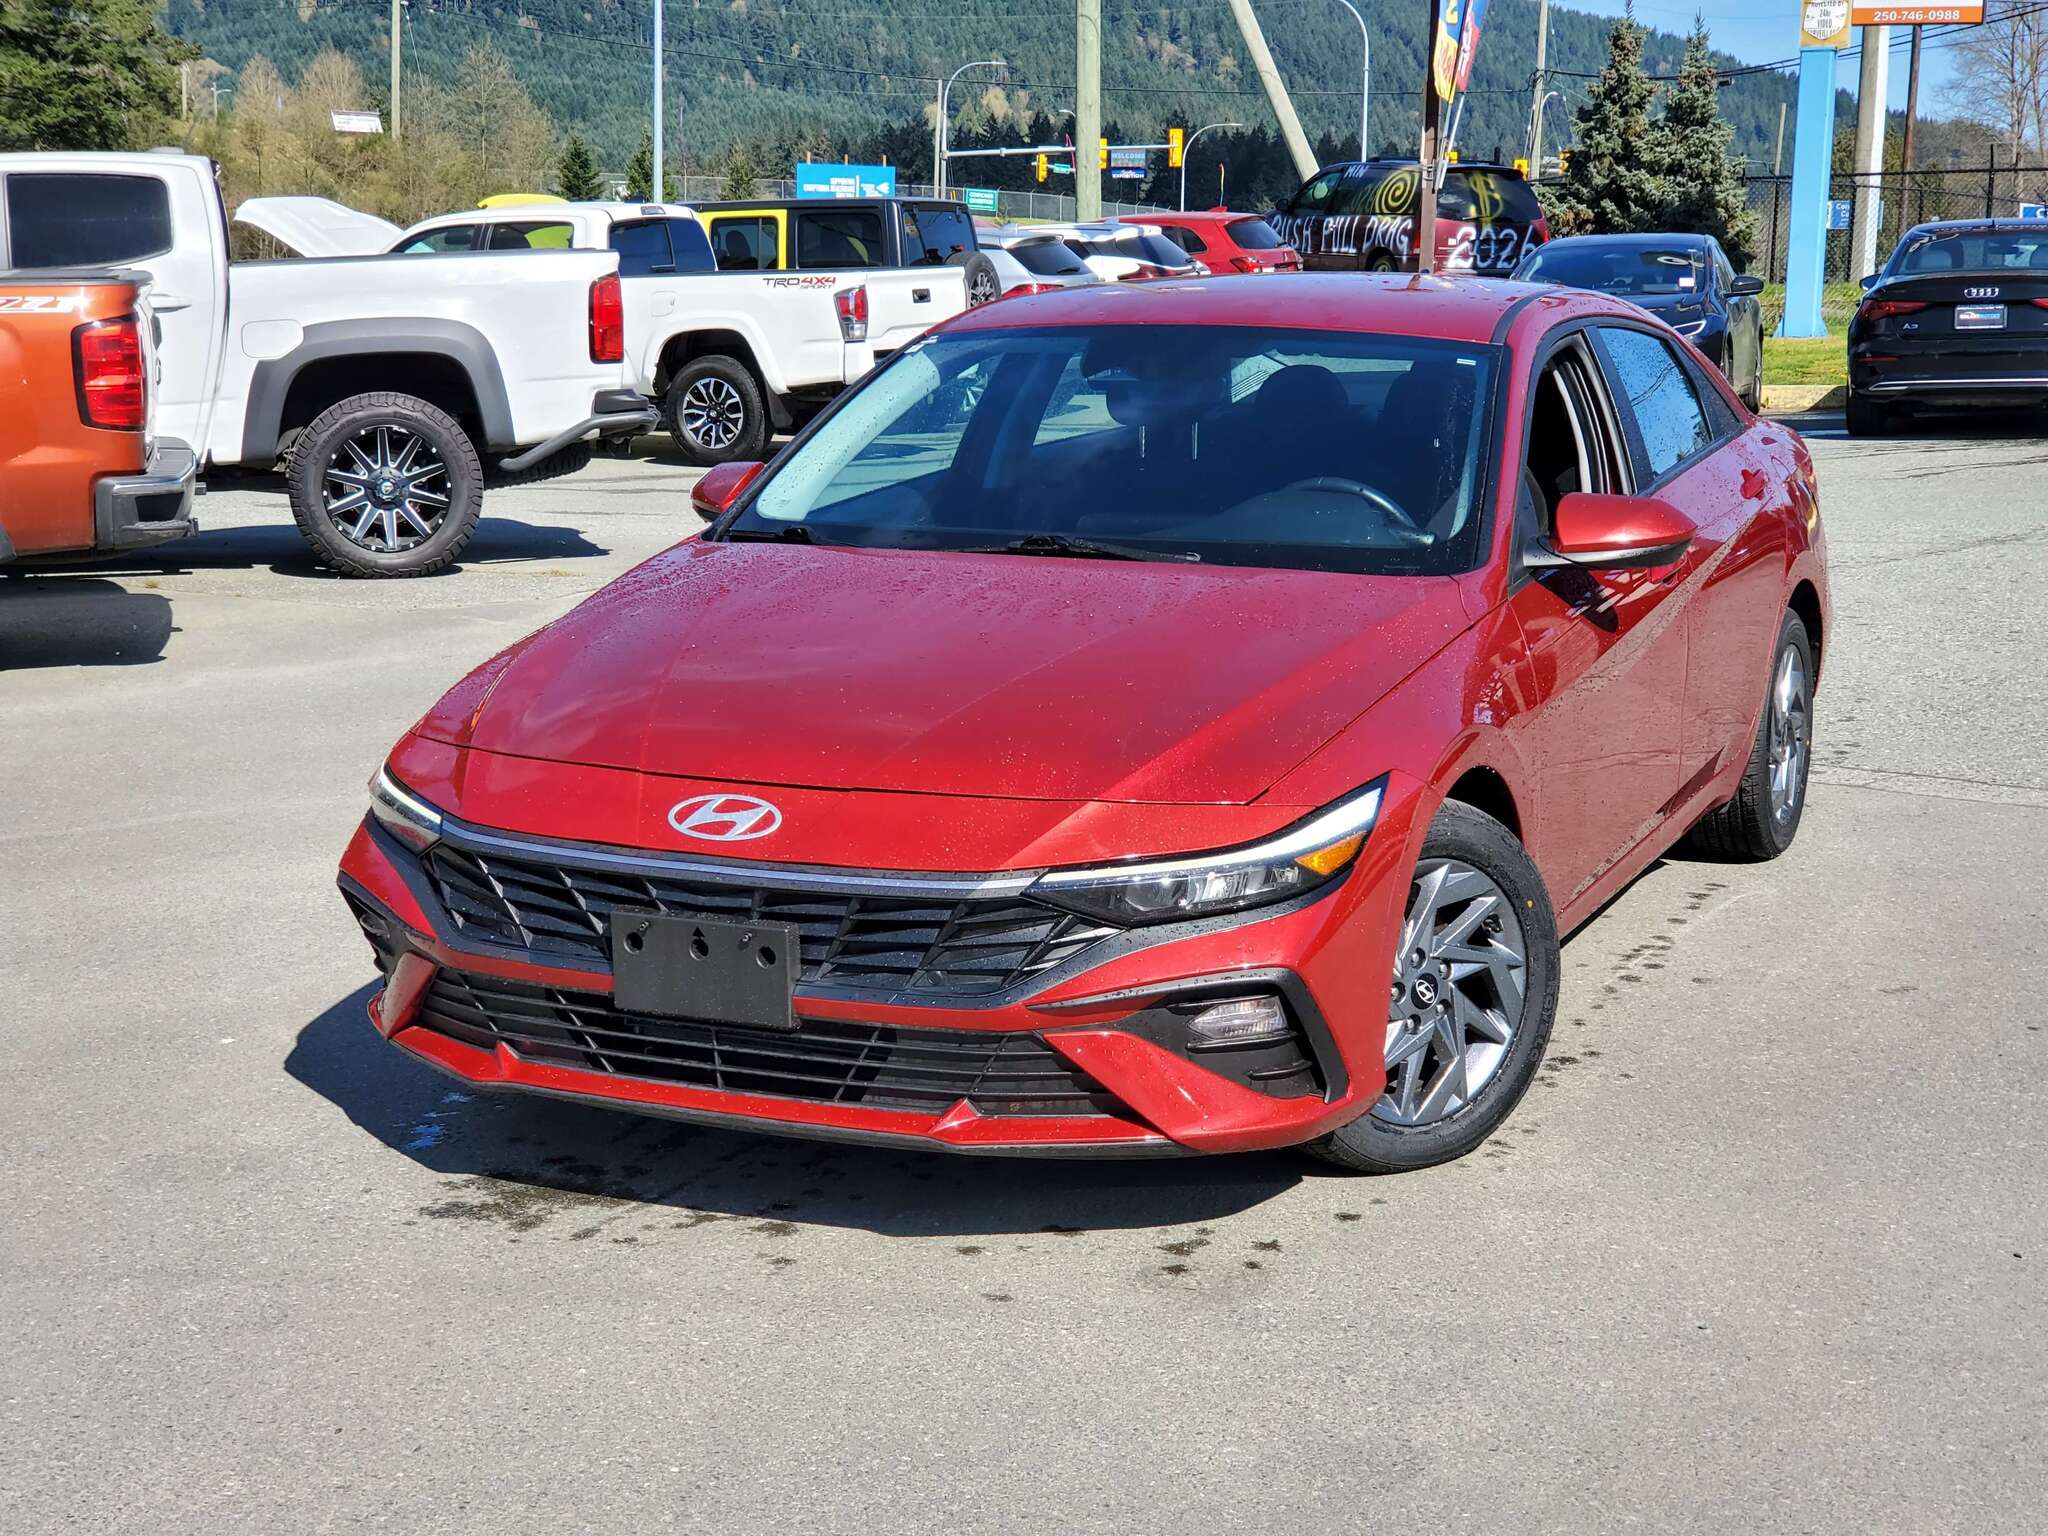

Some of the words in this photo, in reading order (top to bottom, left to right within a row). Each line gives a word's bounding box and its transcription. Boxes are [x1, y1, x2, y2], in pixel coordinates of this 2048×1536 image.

[1873, 10, 1960, 21] 250-746-0988
[1270, 214, 1315, 254] PUSH
[1320, 214, 1360, 254] PULL
[1362, 214, 1412, 264] DRAG
[1446, 224, 1537, 269] 2026
[1902, 322, 1919, 330] A3
